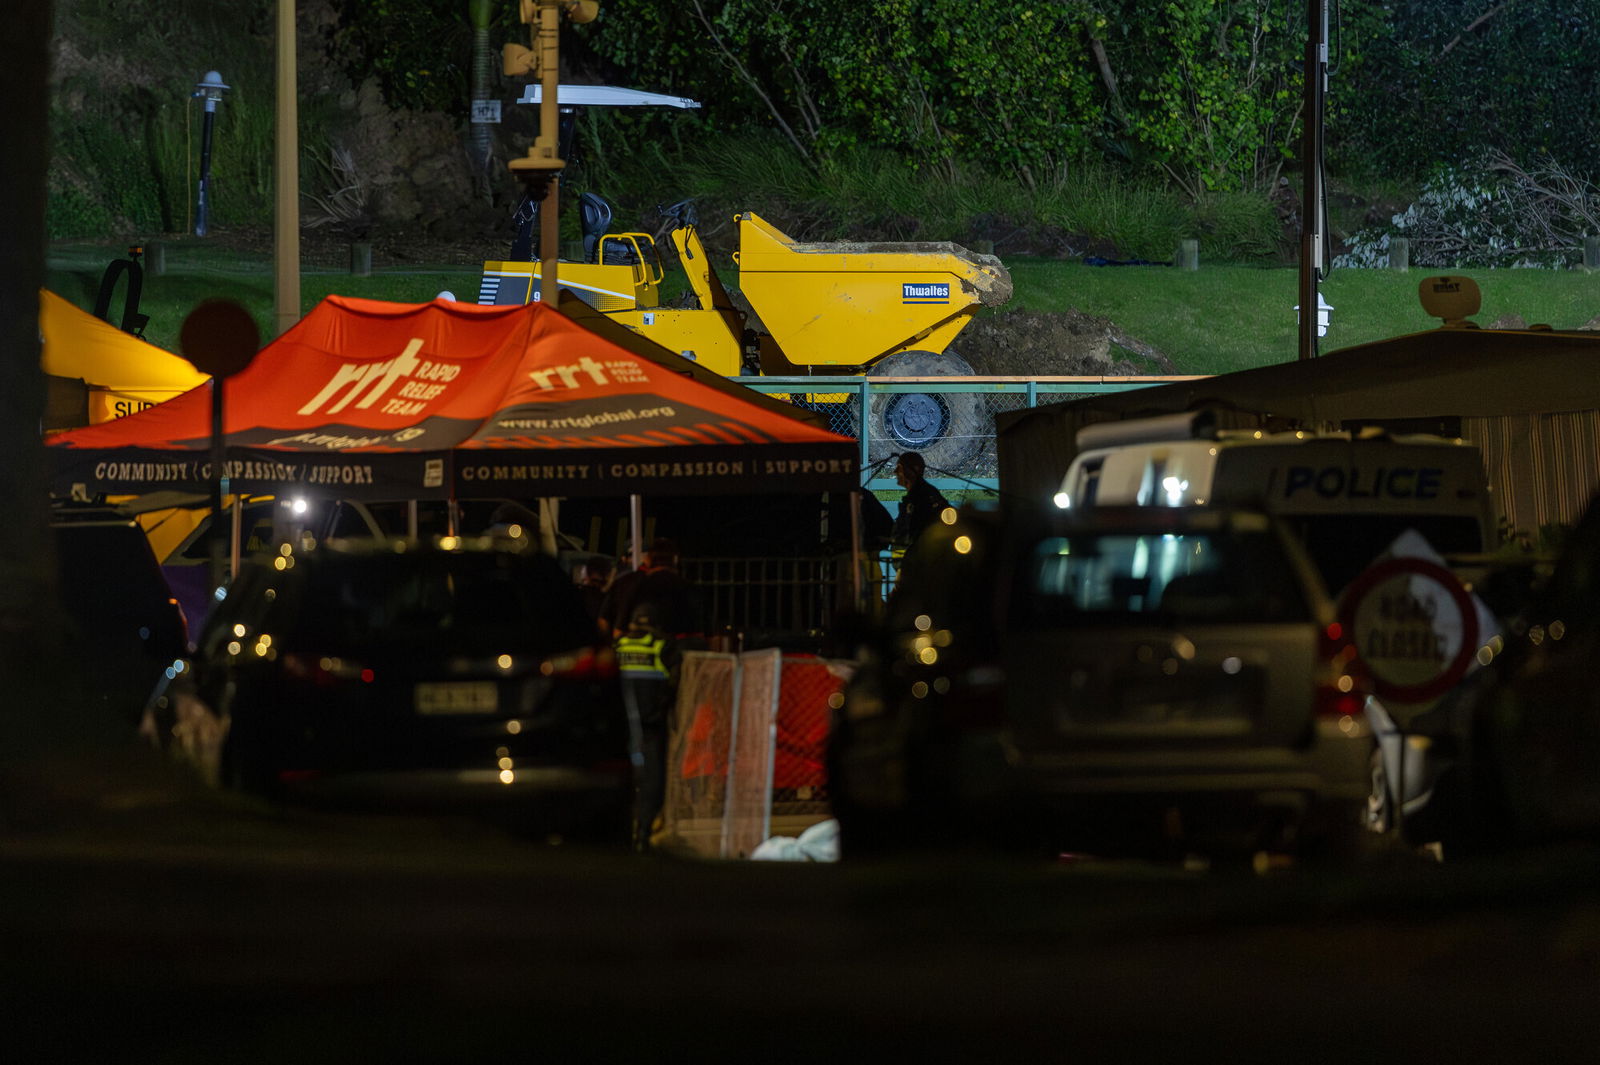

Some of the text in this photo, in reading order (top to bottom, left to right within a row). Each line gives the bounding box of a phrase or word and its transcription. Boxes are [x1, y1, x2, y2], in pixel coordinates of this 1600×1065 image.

[903, 285, 948, 296] Thwaites
[415, 361, 461, 382] RAPID
[528, 356, 609, 391] rrt
[398, 380, 447, 400] RELIEF
[380, 398, 427, 416] TEAM
[498, 405, 676, 429] www.rrtglobal.org
[94, 461, 188, 481] COMMUNITY
[201, 460, 298, 481] CMPASSION
[461, 464, 591, 481] COMMUNITY
[609, 460, 745, 478] COMPASSION
[764, 458, 853, 475] SUPPORT
[1285, 467, 1443, 499] POLICE
